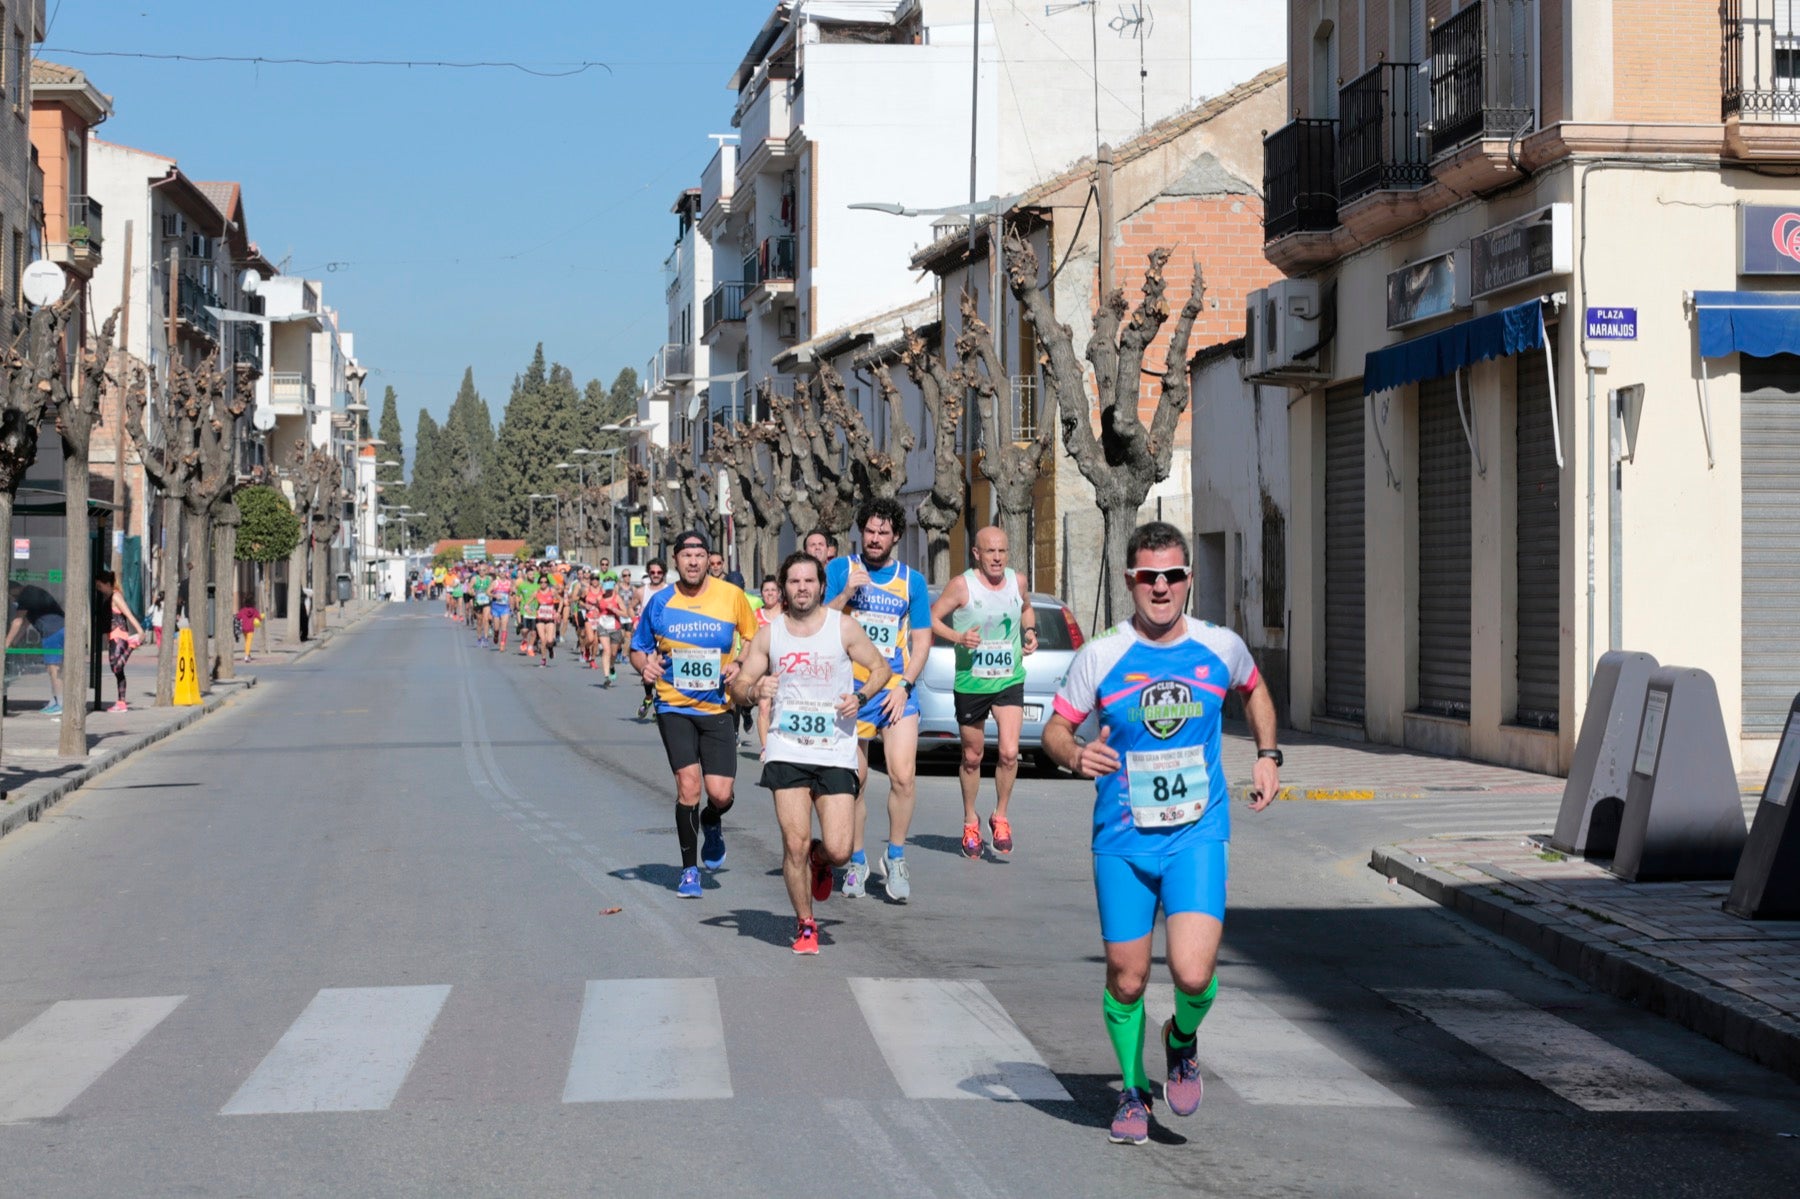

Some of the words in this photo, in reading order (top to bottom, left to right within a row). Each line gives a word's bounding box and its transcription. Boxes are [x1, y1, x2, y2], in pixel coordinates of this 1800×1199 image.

[1597, 310, 1624, 319] PLAZA
[1589, 323, 1634, 337] NARANJOS
[851, 593, 904, 608] agustinos
[668, 620, 722, 634] agustinos
[863, 624, 889, 643] 93
[778, 651, 811, 675] 525
[975, 651, 1012, 666] 1046
[180, 657, 185, 682] 9
[680, 661, 713, 678] 486
[788, 714, 826, 733] 338
[1152, 773, 1188, 801] 84
